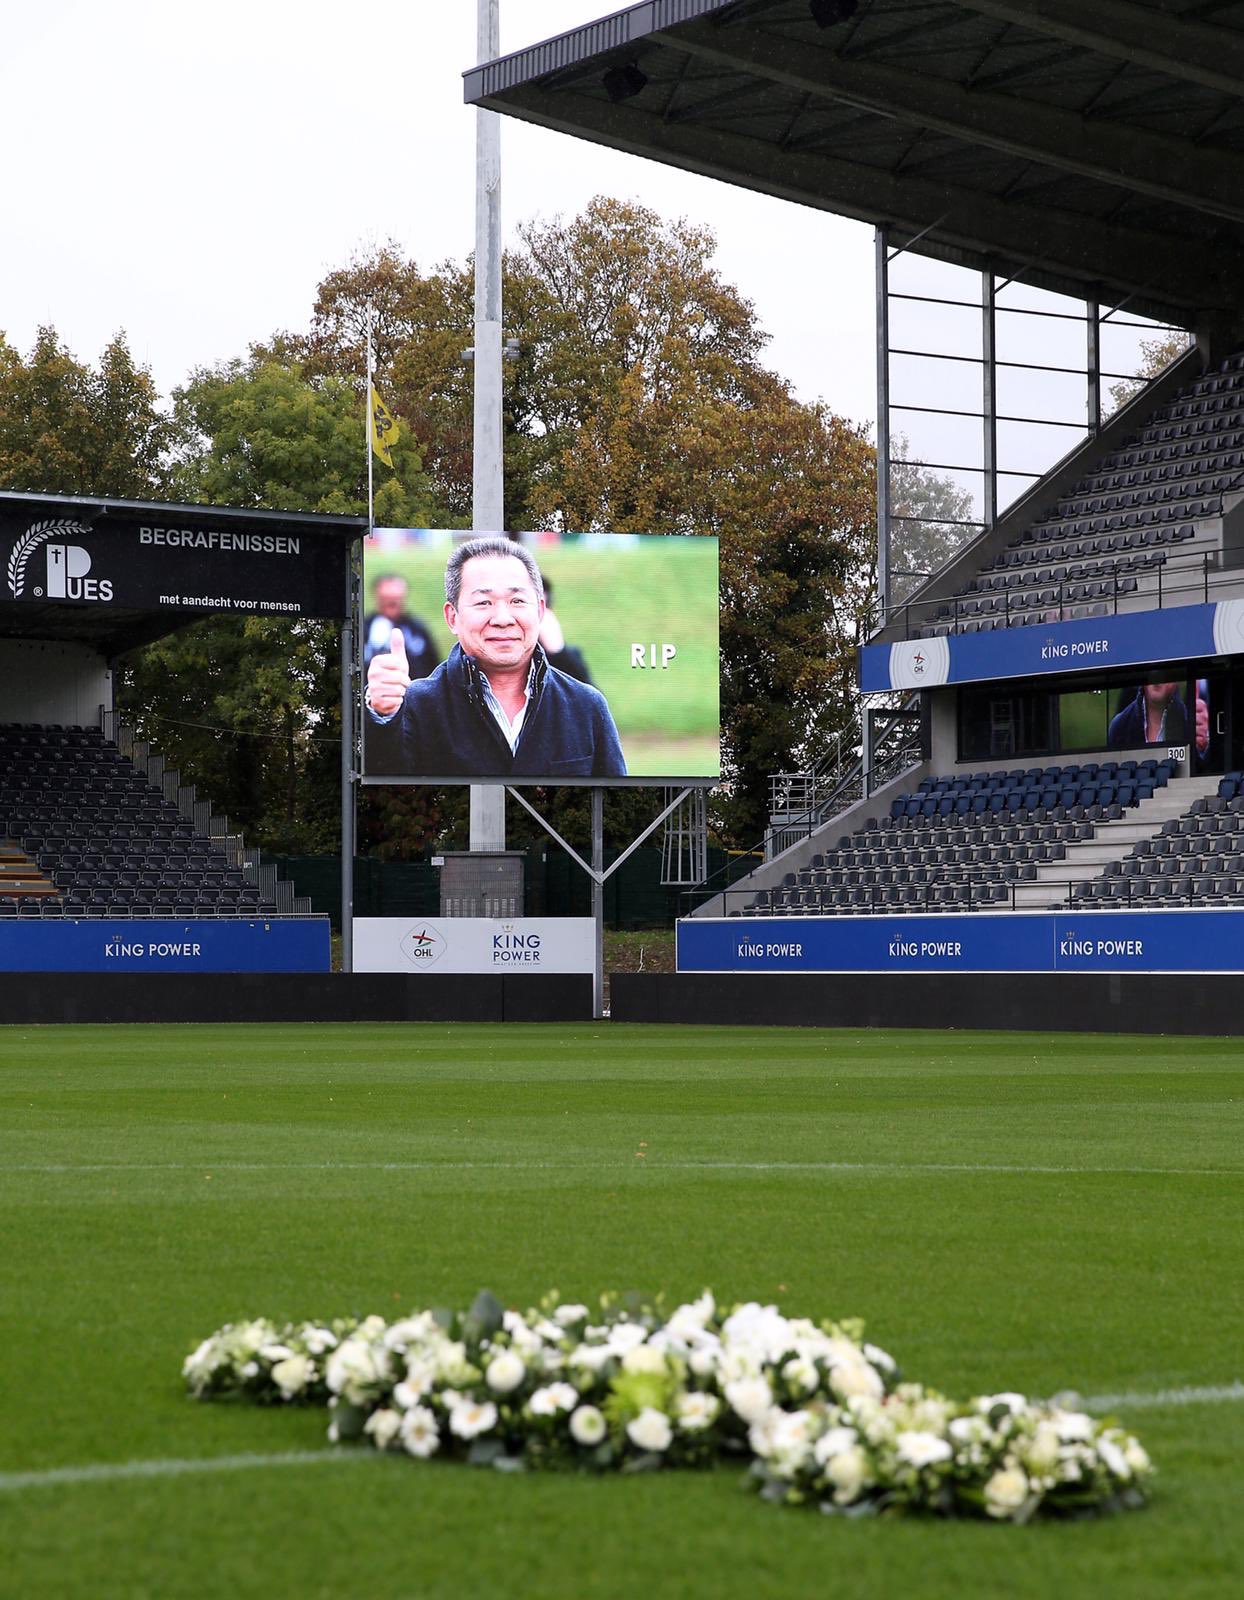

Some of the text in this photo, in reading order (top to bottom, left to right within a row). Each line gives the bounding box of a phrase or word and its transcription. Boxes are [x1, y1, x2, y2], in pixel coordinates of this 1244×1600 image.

[139, 527, 301, 555] BEGRAFENISSEN
[159, 594, 301, 612] met aandacht voor mensen
[631, 642, 676, 669] RIP
[1041, 640, 1109, 660] KING POWER
[1168, 748, 1185, 760] 300
[493, 934, 541, 949] KING
[1060, 940, 1143, 956] KING POWER
[105, 943, 201, 957] KING POWER
[413, 948, 433, 958] OHL
[493, 951, 540, 961] POWER
[738, 944, 802, 957] KING POWER
[889, 942, 962, 956] KING POWER
